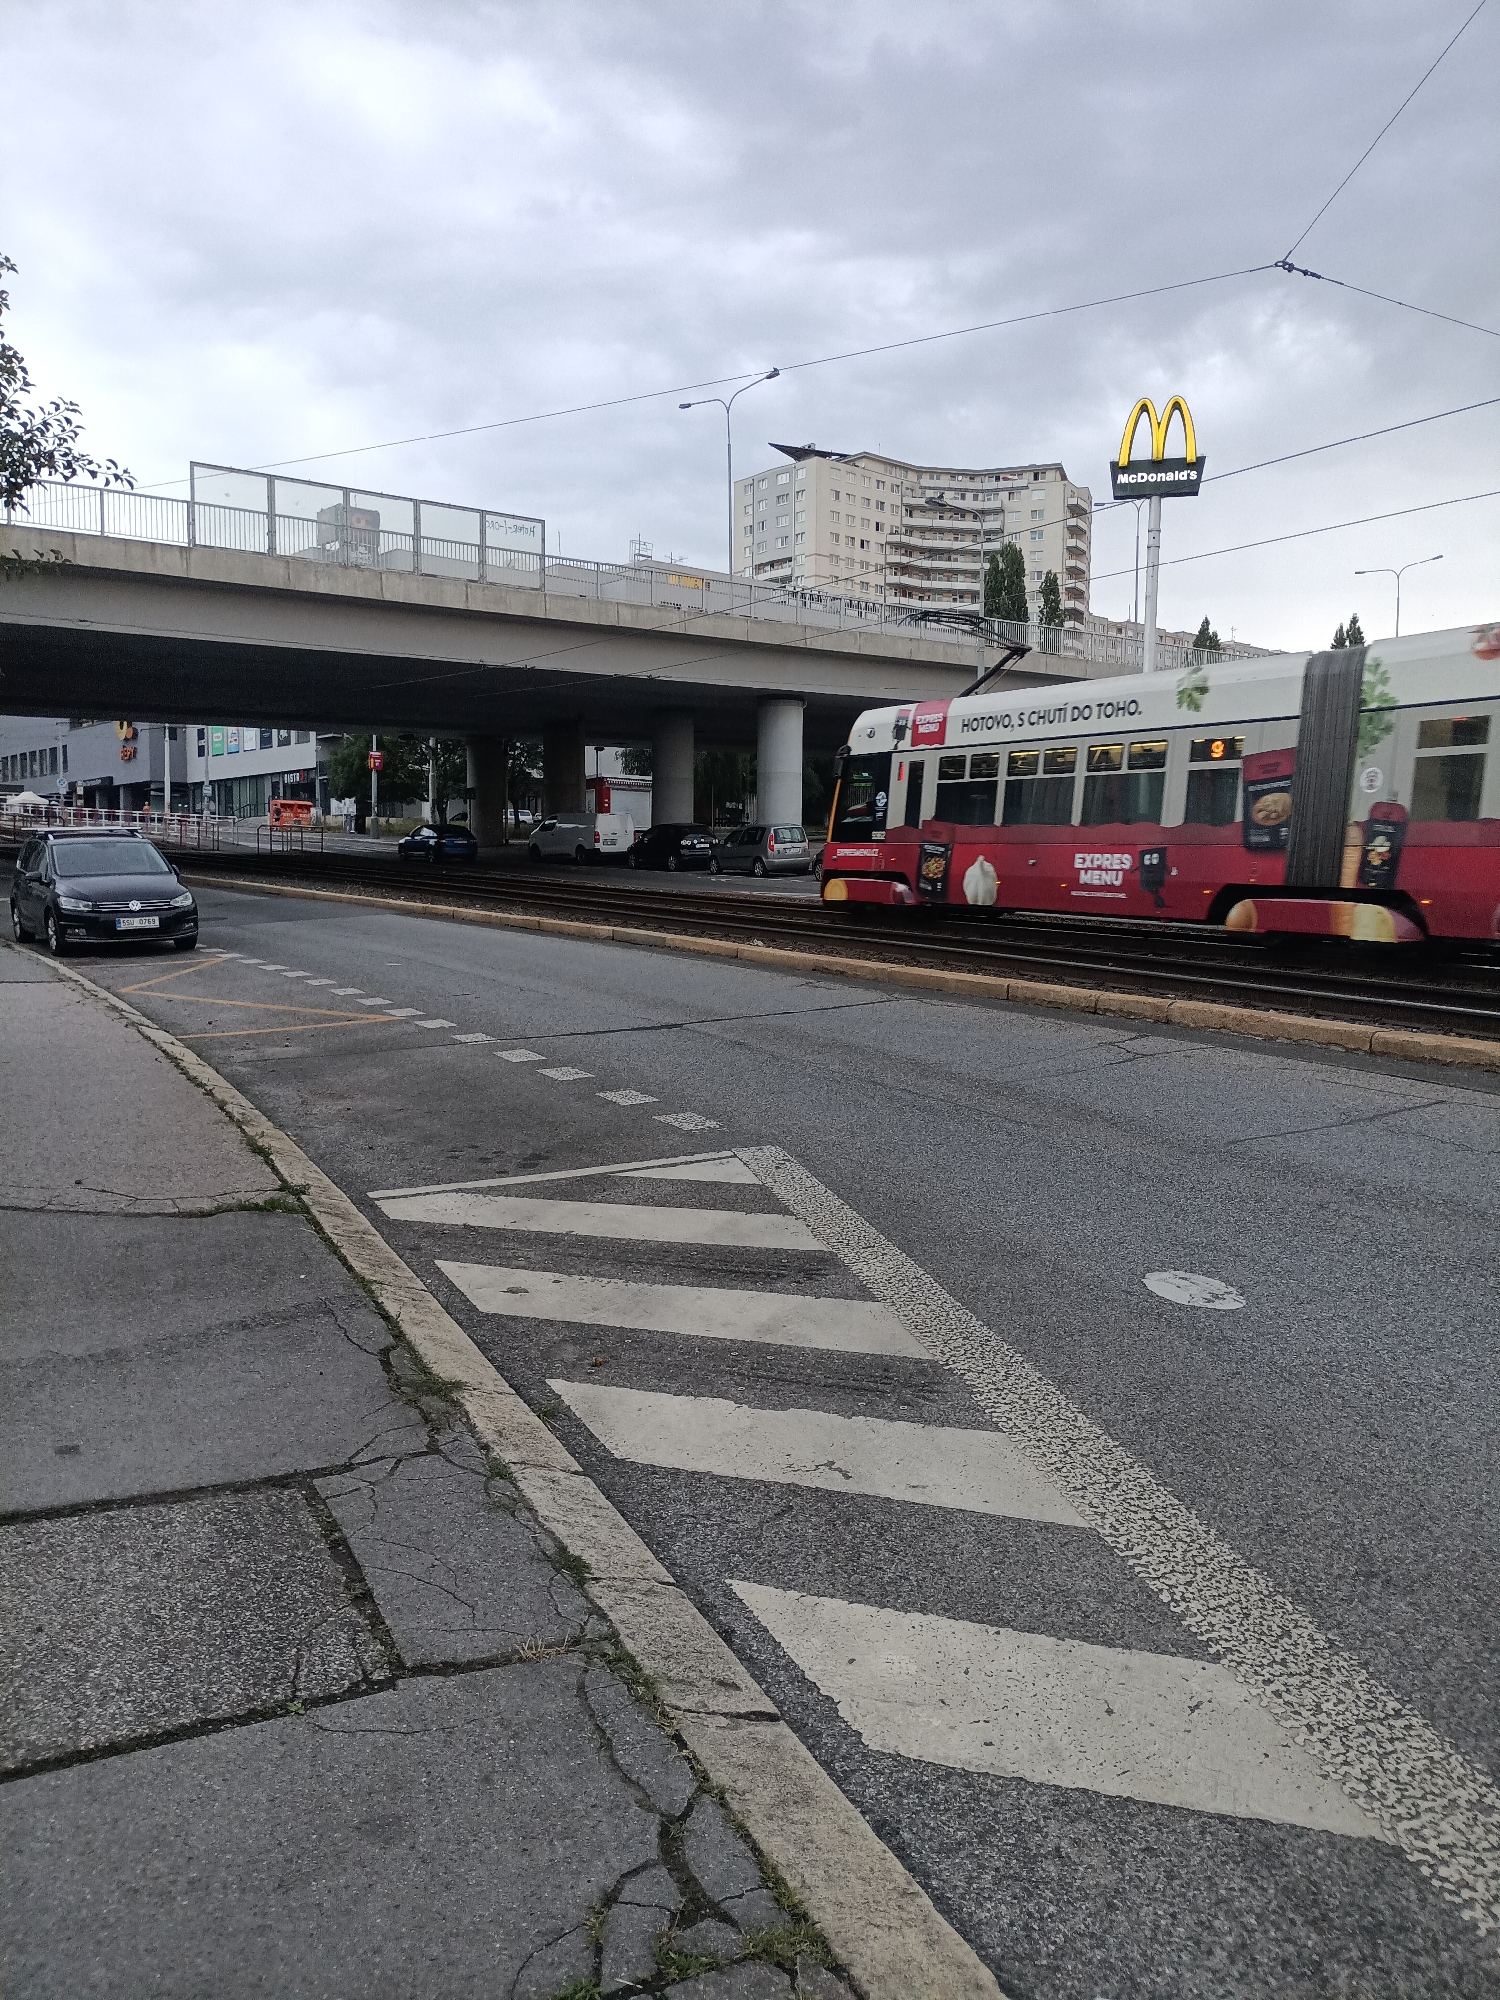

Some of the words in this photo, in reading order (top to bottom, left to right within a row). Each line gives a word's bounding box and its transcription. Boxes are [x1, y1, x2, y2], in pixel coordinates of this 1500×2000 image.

[1117, 470, 1198, 484] McDonald's
[960, 713, 1015, 733] HOTOVO,
[1017, 712, 1026, 728] S
[1028, 702, 1069, 727] CHUTÍ
[1071, 705, 1092, 722] DO
[1095, 699, 1143, 719] TOHO.
[1210, 740, 1225, 759] 9
[1074, 853, 1133, 870] EXPRES
[1079, 870, 1124, 887] MENU
